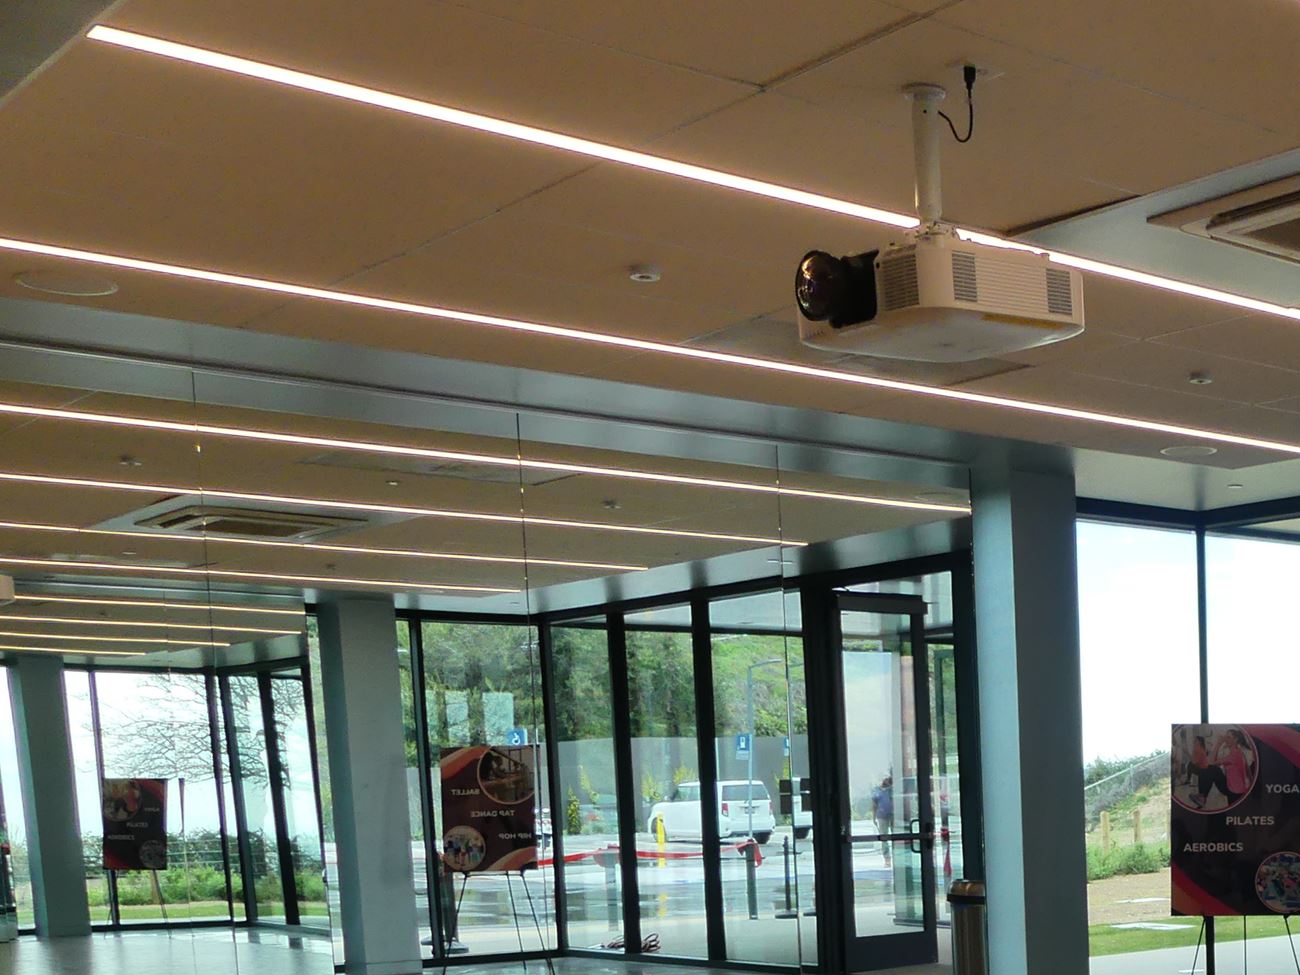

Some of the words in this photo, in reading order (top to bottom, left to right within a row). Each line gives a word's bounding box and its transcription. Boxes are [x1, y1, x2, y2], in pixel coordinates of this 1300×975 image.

[1265, 784, 1300, 793] YOGA
[1225, 816, 1275, 825] PILATES
[1183, 842, 1244, 852] AEROBICS
